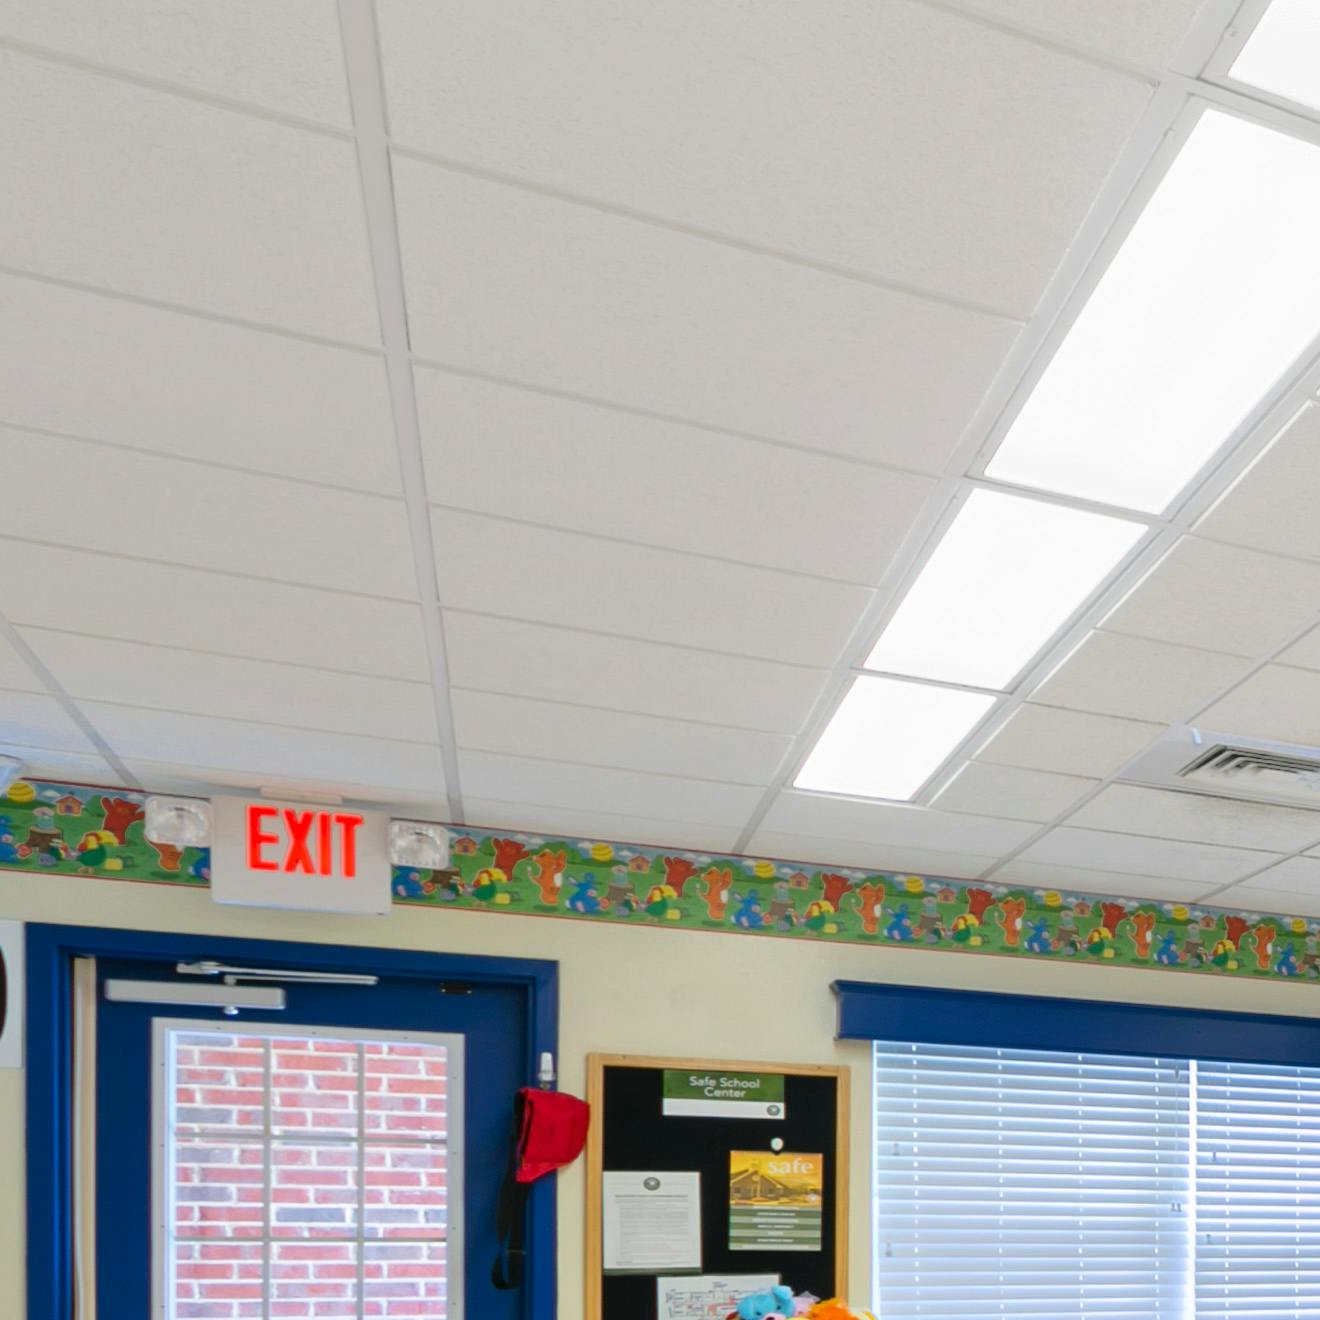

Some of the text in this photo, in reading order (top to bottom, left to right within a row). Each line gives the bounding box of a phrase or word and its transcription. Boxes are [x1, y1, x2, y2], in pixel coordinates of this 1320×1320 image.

[247, 804, 364, 878] EXIT
[688, 1076, 761, 1088] Safe School
[703, 1086, 747, 1098] Center
[768, 1158, 814, 1174] safe
